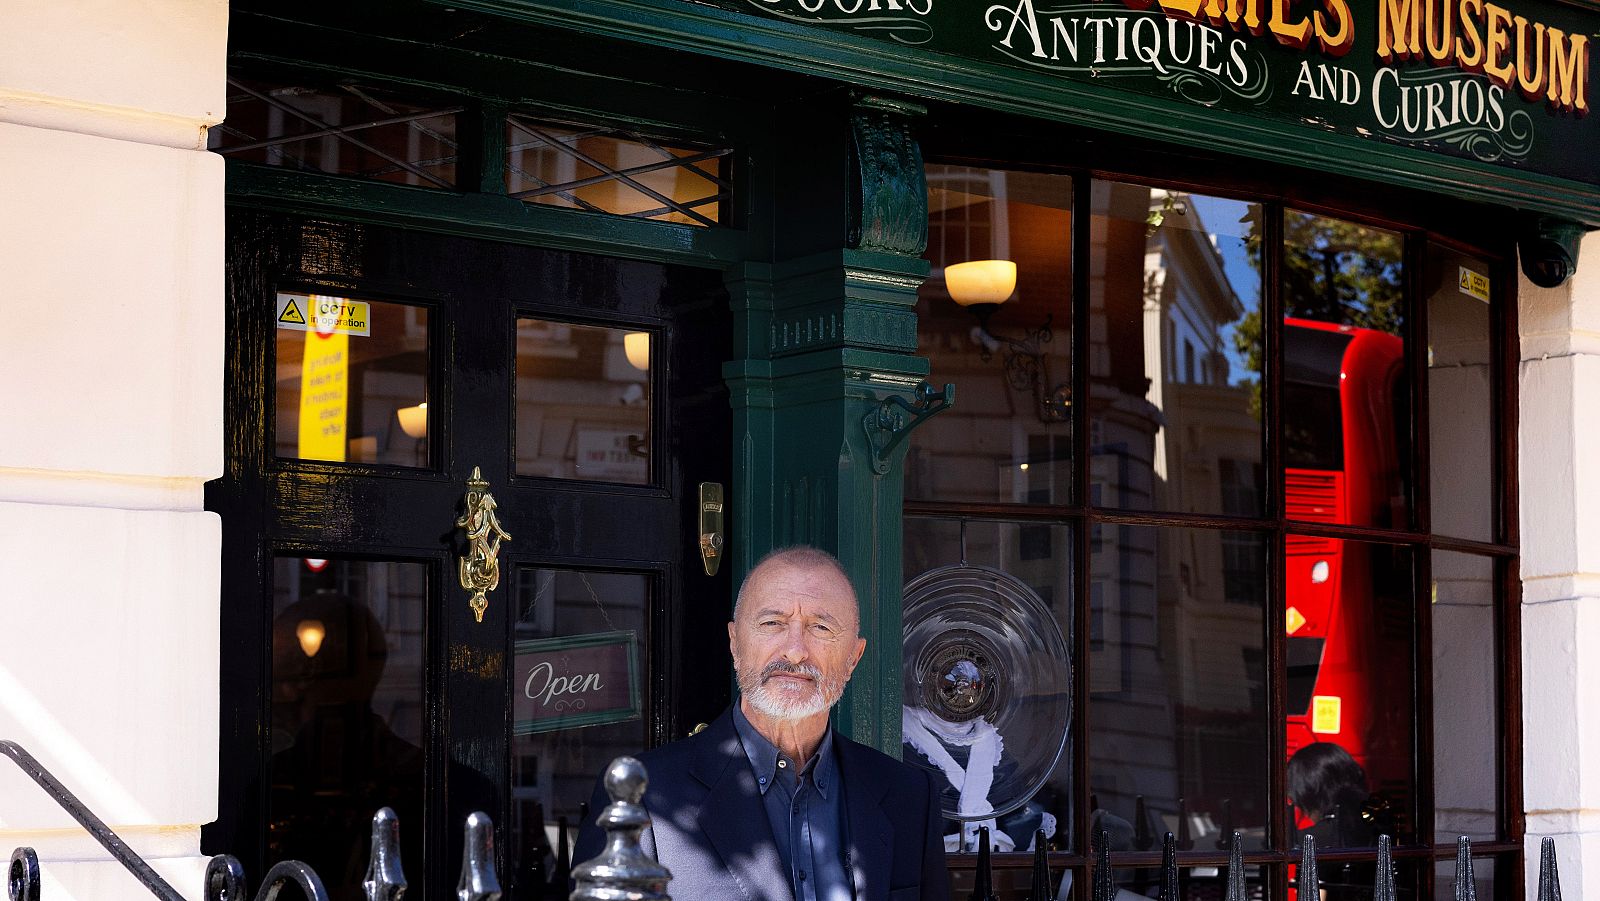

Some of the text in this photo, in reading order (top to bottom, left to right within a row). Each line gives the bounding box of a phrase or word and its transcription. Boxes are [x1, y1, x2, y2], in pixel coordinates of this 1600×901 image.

[985, 0, 1248, 87] ANTIQUES
[1376, 0, 1590, 110] MUSEUM
[1291, 60, 1505, 132] AND CURIOS
[310, 314, 365, 328] in operation
[320, 303, 356, 317] CCTV
[525, 661, 604, 706] Open
